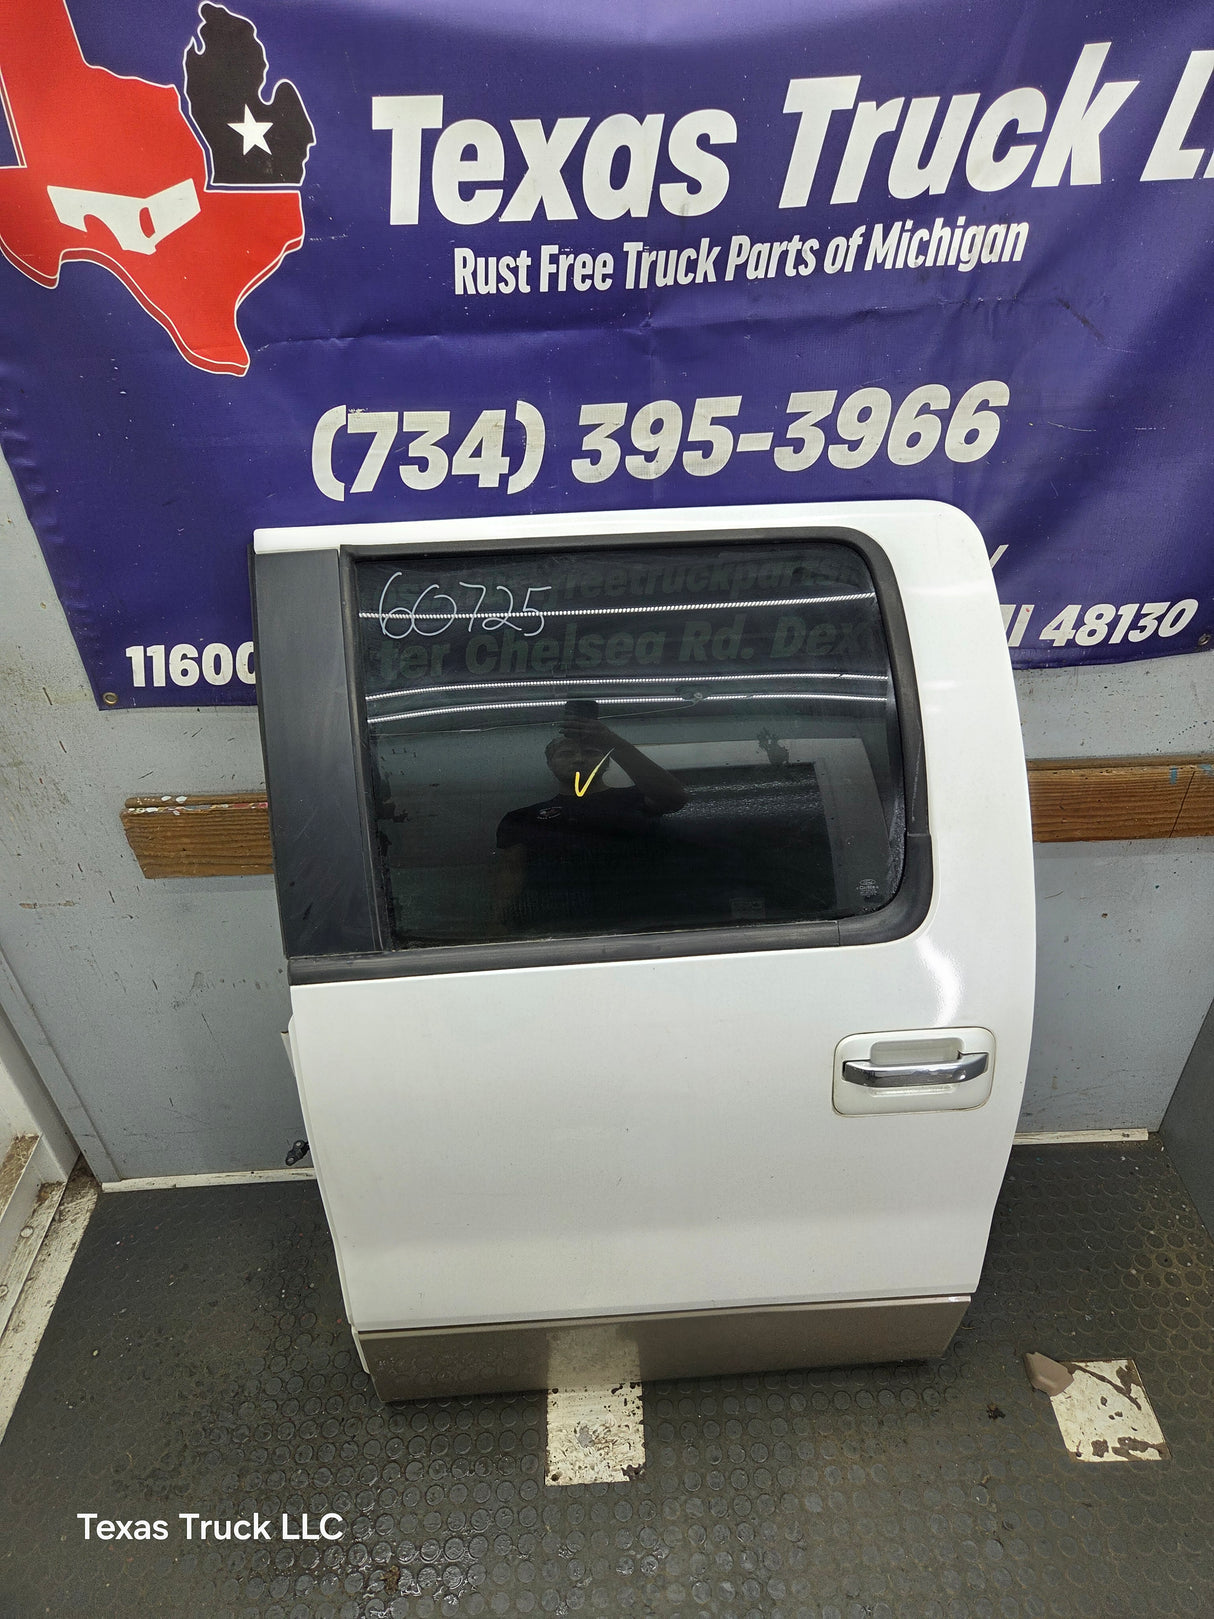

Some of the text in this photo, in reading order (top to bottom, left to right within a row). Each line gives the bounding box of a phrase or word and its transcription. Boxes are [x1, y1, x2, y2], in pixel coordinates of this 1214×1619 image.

[371, 42, 1214, 226] Texas Truck L
[454, 215, 1030, 295] Rust Free Truck Parts of Michigan
[311, 380, 1011, 502] (734) 395-3966
[379, 571, 553, 640] 60725
[465, 618, 667, 675] Chelsea
[678, 612, 756, 662] Rd.
[1038, 598, 1199, 648] 48130
